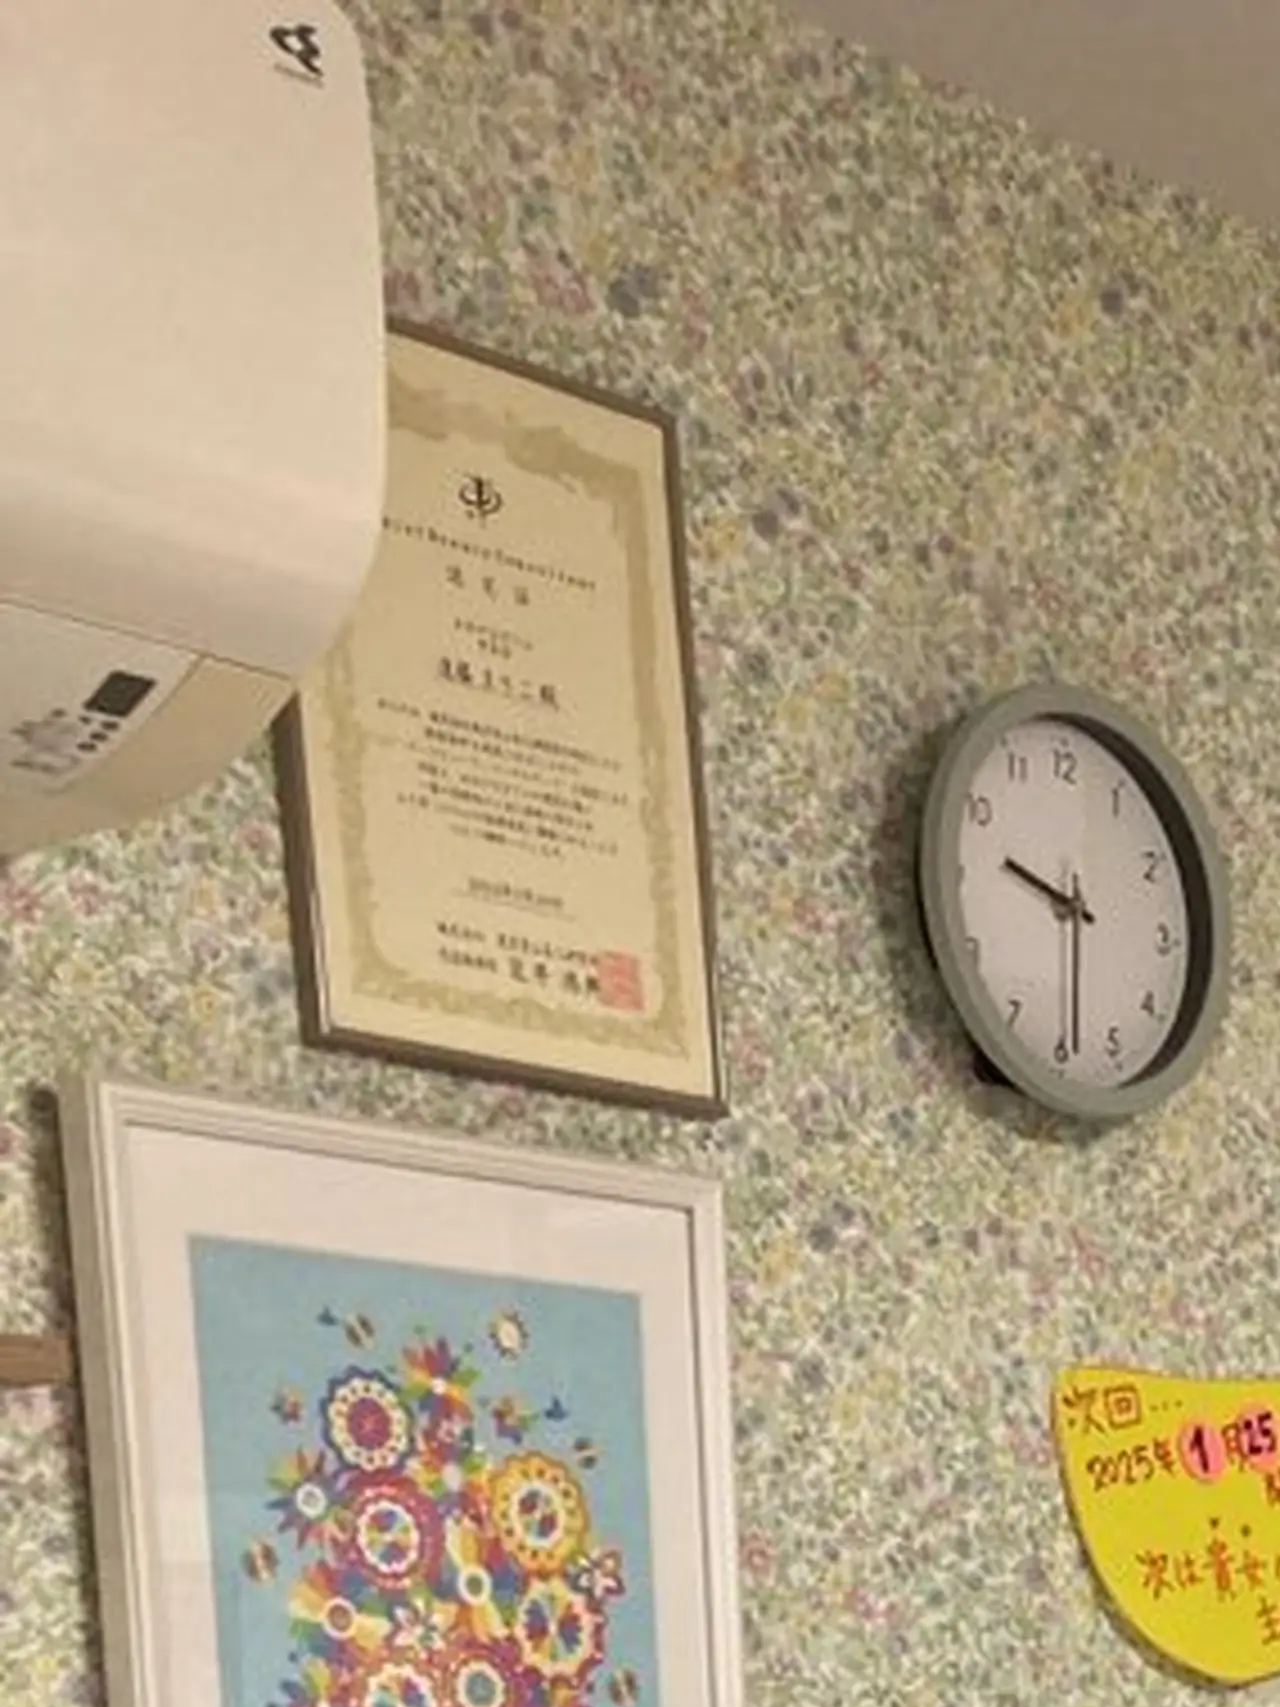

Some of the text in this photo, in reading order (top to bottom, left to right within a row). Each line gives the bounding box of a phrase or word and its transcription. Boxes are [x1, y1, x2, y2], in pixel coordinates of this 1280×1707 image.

[1007, 752, 1028, 783] 11
[1052, 749, 1078, 785] 12
[967, 794, 994, 826] 10
[1141, 849, 1158, 883] 2
[1154, 922, 1172, 956] 3
[1007, 998, 1024, 1029] 7
[1140, 991, 1156, 1017] 4
[1053, 1037, 1070, 1064] 6
[1106, 1026, 1121, 1058] 5
